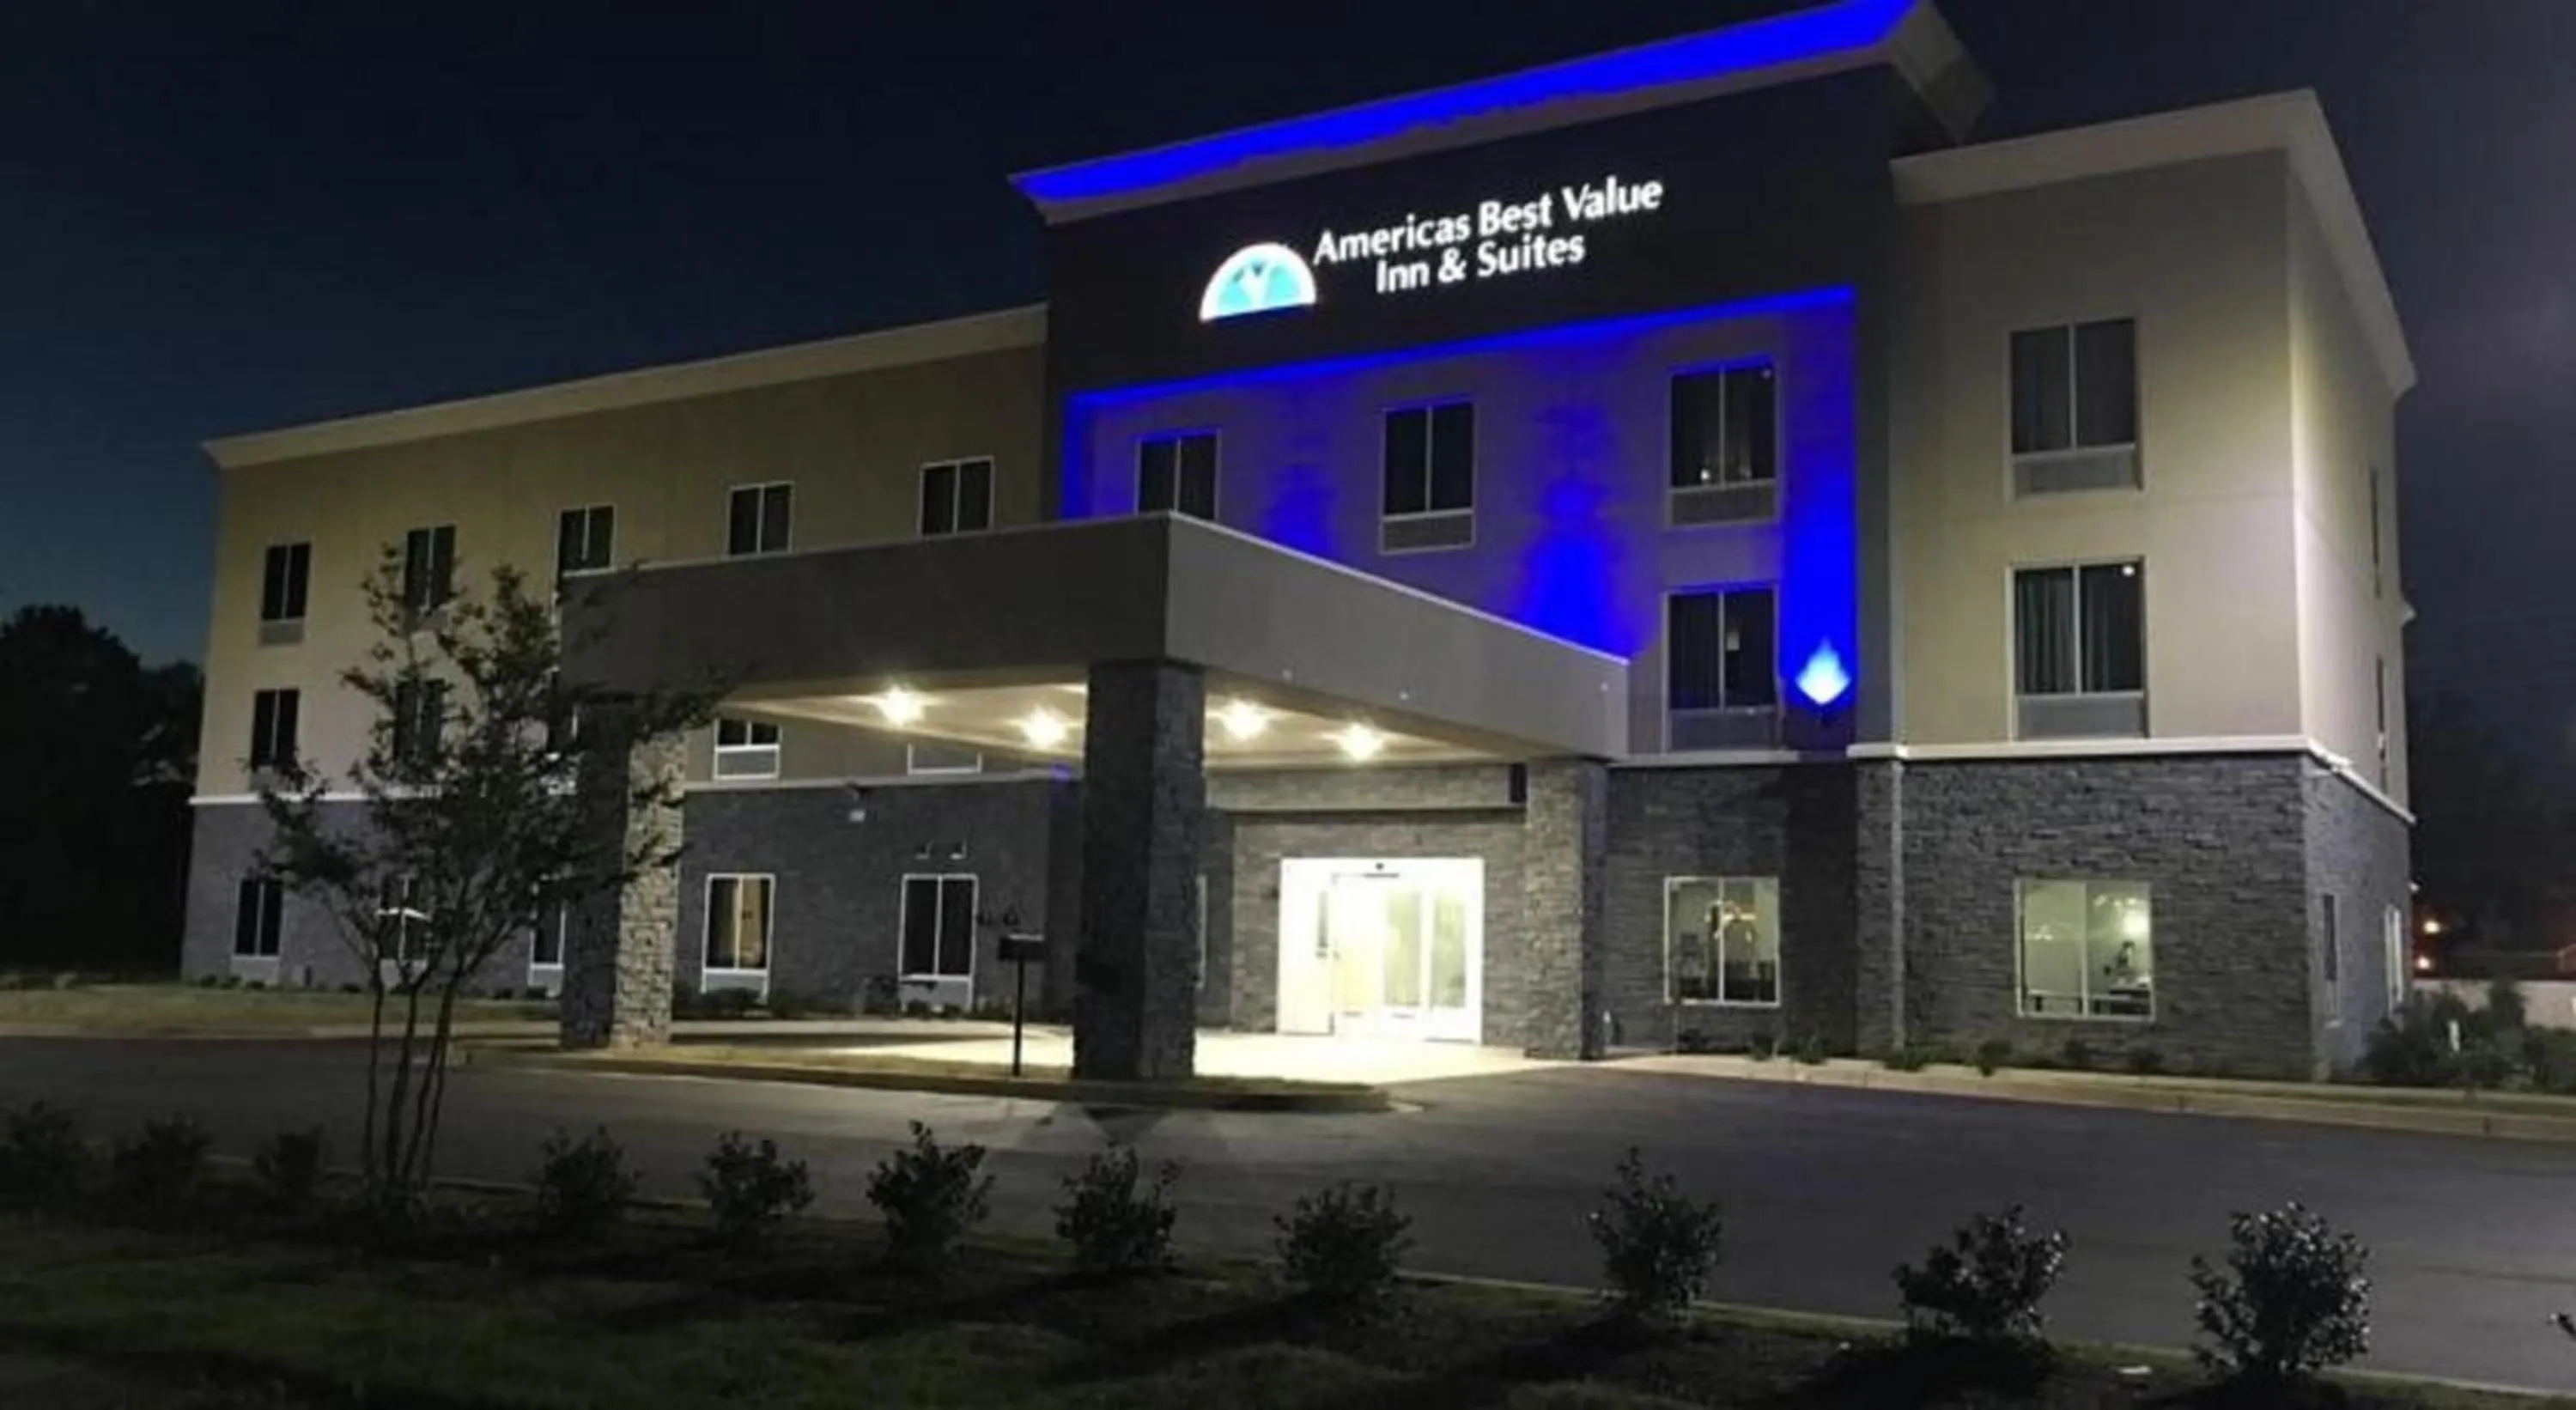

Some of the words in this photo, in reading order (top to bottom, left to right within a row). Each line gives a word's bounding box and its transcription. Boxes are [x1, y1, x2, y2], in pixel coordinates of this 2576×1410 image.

[1312, 212, 1472, 266] Americas
[1477, 191, 1553, 237] Best
[1561, 174, 1664, 222] Value
[1376, 258, 1431, 294] Inn
[1437, 246, 1467, 284] &
[1477, 231, 1587, 279] Suites
